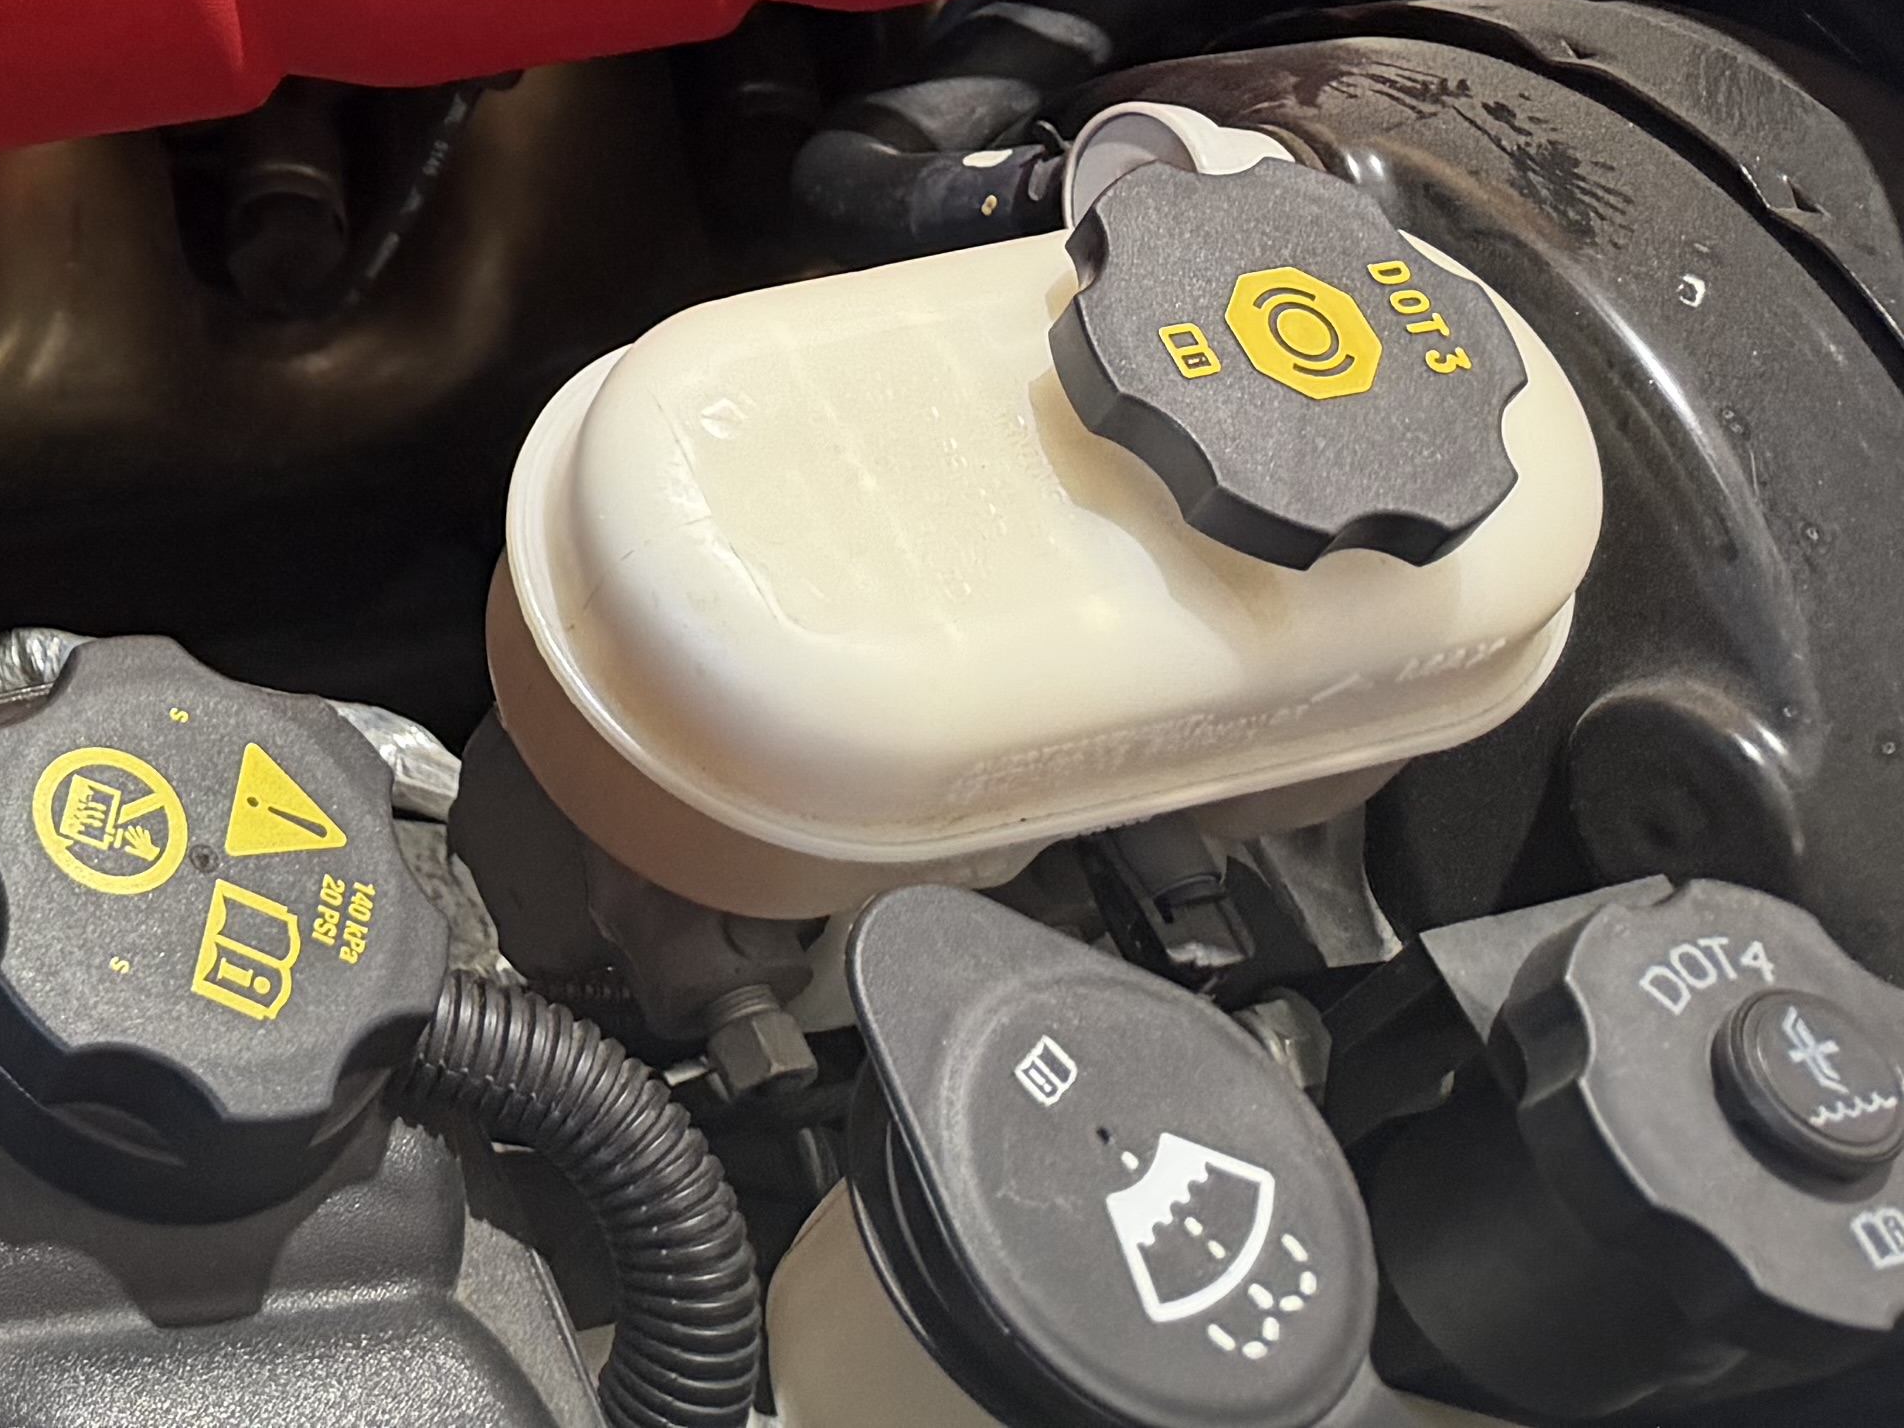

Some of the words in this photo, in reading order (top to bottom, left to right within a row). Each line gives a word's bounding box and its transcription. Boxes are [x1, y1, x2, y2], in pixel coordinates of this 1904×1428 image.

[1366, 260, 1453, 340] DOT
[1424, 347, 1474, 376] 3
[319, 873, 346, 907] 20
[348, 881, 376, 922] 140
[311, 904, 341, 947] PSI
[338, 919, 369, 965] kPa
[1639, 936, 1738, 1016] DOT
[1739, 940, 1776, 984] 4
